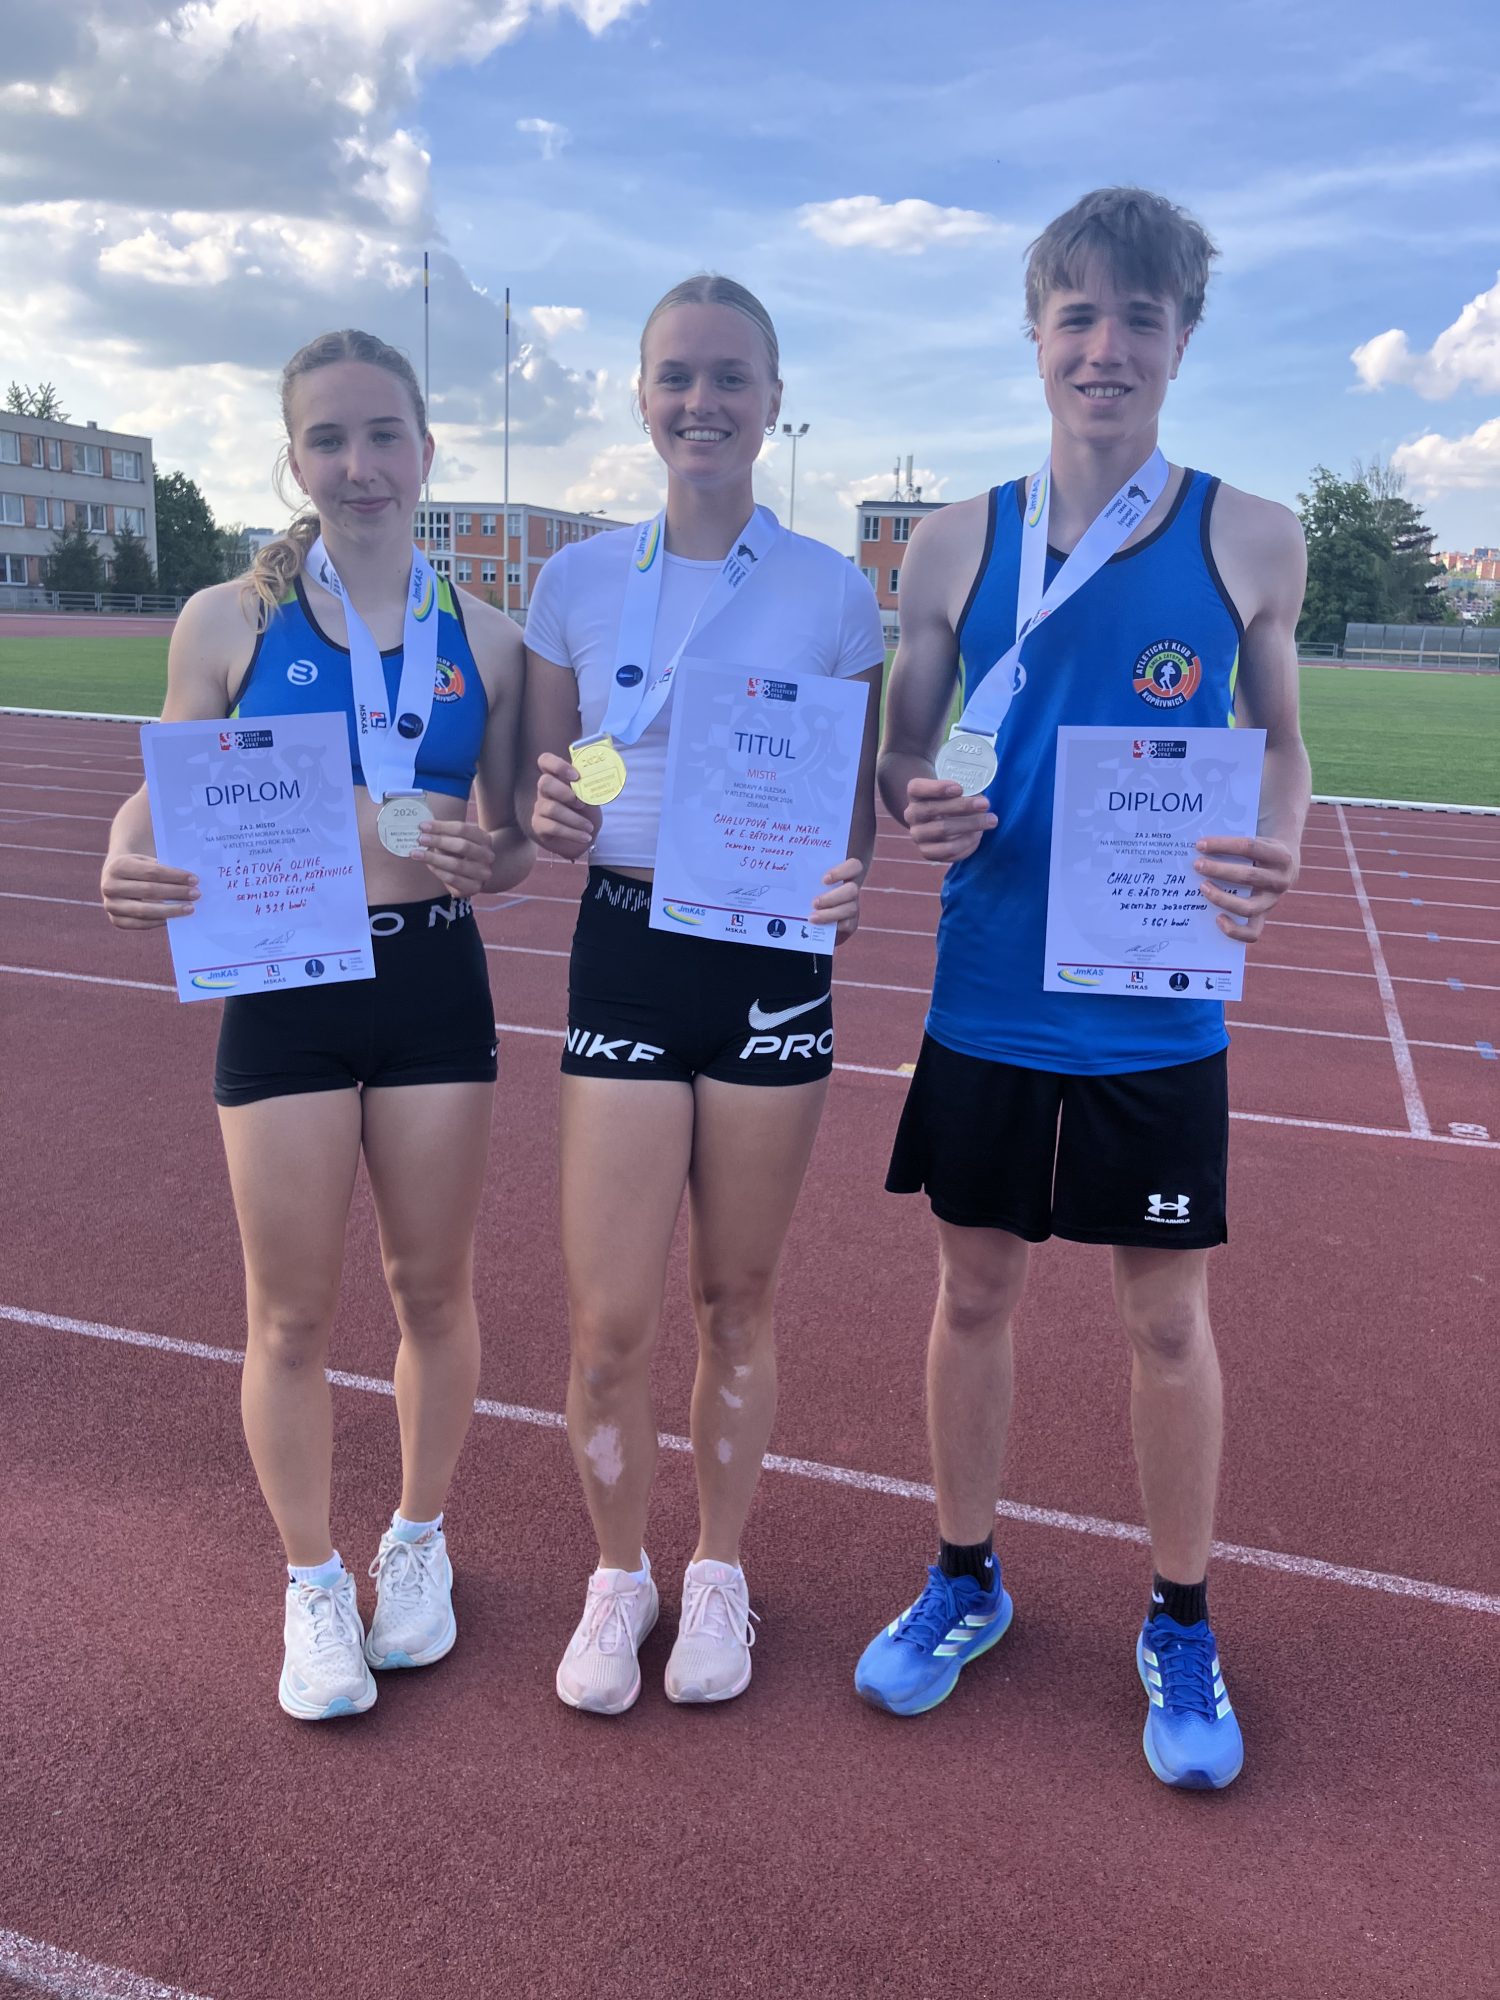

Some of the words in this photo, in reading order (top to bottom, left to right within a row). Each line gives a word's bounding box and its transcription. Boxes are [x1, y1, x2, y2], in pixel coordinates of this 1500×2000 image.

[412, 567, 424, 603] JmKAS
[1135, 639, 1169, 675] ATLETICKÝ
[1171, 642, 1192, 658] KLUB
[1141, 690, 1184, 708] KOPŘIVNICE
[359, 704, 369, 735] MSKAS
[734, 731, 796, 760] TITUL
[955, 743, 983, 756] 2026
[747, 768, 777, 781] MISTR
[205, 780, 301, 806] DIPLOM
[1108, 791, 1203, 812] DIPLOM
[393, 808, 418, 817] 2026
[713, 813, 769, 829] CHALUPOVÁ
[772, 822, 791, 832] ANNA
[796, 825, 820, 834] MARIE
[290, 856, 321, 870] OLIVIE
[1107, 871, 1155, 885] CHALUPA
[1163, 873, 1186, 885] JAN
[1112, 888, 1122, 896] AK
[677, 905, 706, 916] JmKAS
[725, 927, 747, 935] MSKAS
[207, 968, 239, 980] JmKAS
[1073, 967, 1104, 977] JmKAS
[263, 977, 287, 985] MSKAS
[738, 1028, 834, 1061] PRO
[1144, 1215, 1165, 1223] UNDER
